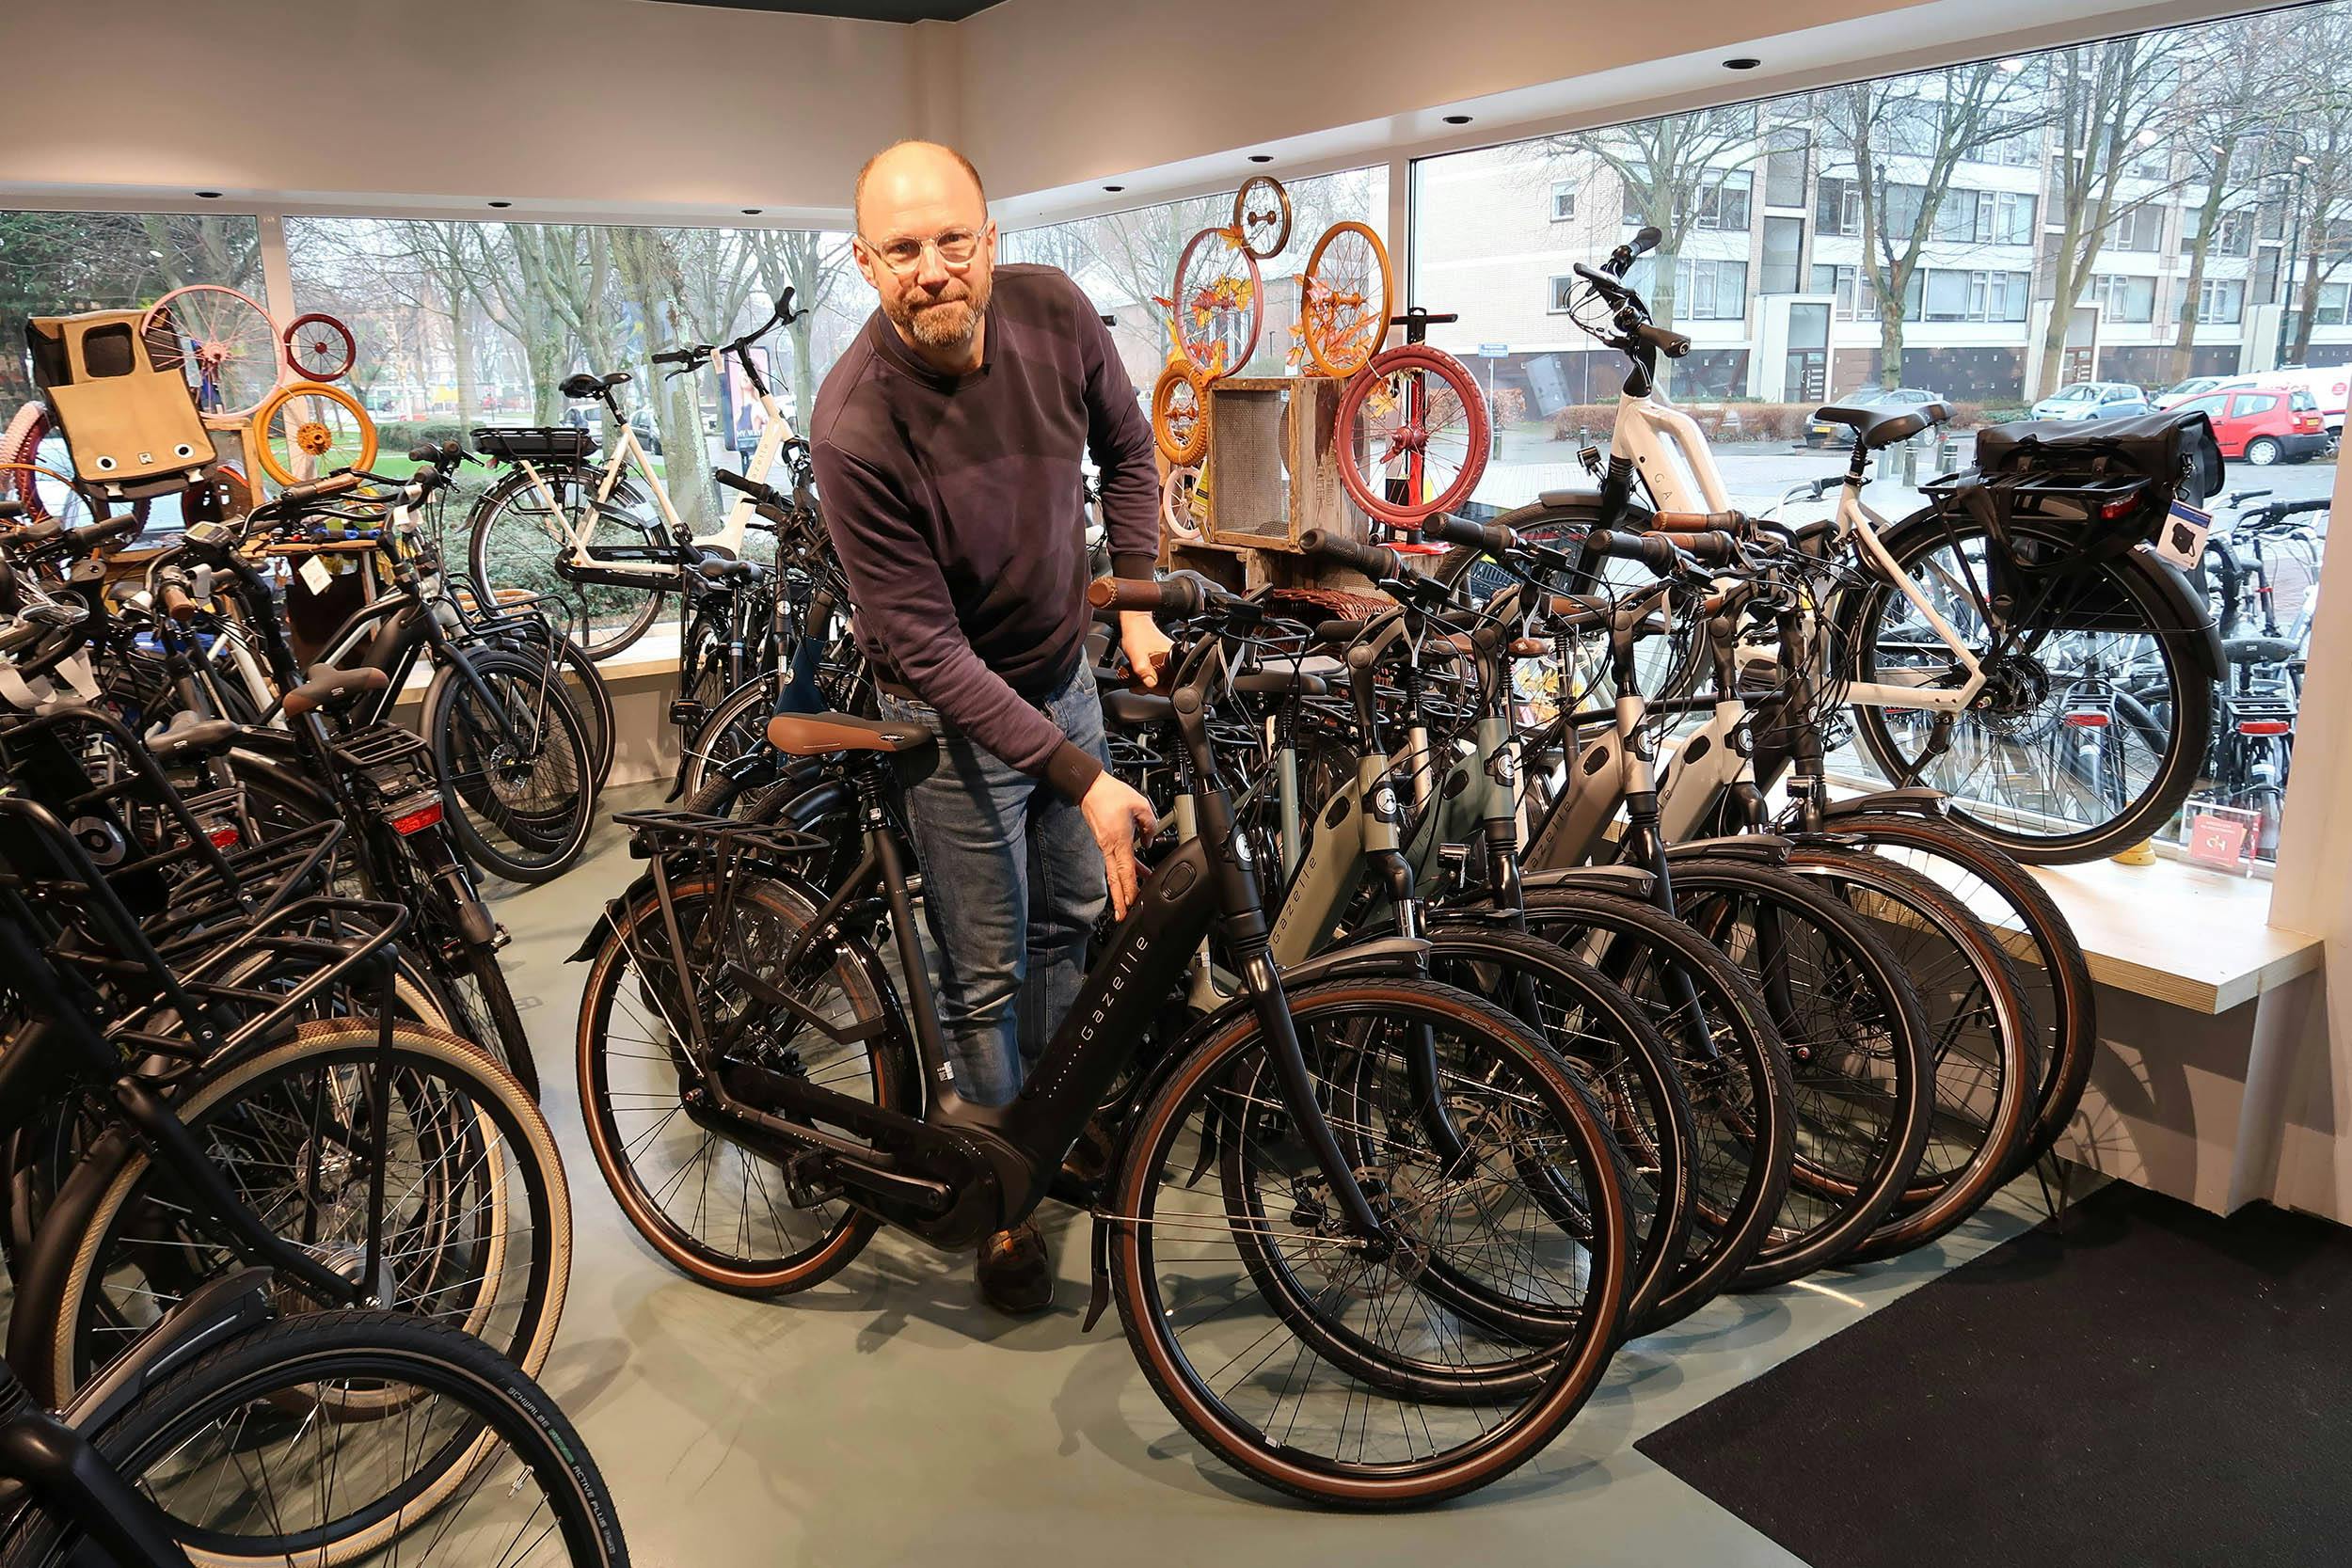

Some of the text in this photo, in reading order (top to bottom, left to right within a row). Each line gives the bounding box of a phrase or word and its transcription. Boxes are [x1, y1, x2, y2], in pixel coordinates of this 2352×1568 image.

[1530, 802, 1572, 868] azelle
[1272, 857, 1317, 944] Gazelle
[1081, 936, 1149, 1041] Gazelle
[1459, 1012, 1504, 1037] SCHWALBE
[1534, 1059, 1576, 1104] ACTIVE PLUS
[1764, 1055, 1774, 1078] PLUS
[506, 1386, 551, 1429] SCHWALBE
[572, 1465, 608, 1528] ACTIVE PLUS
